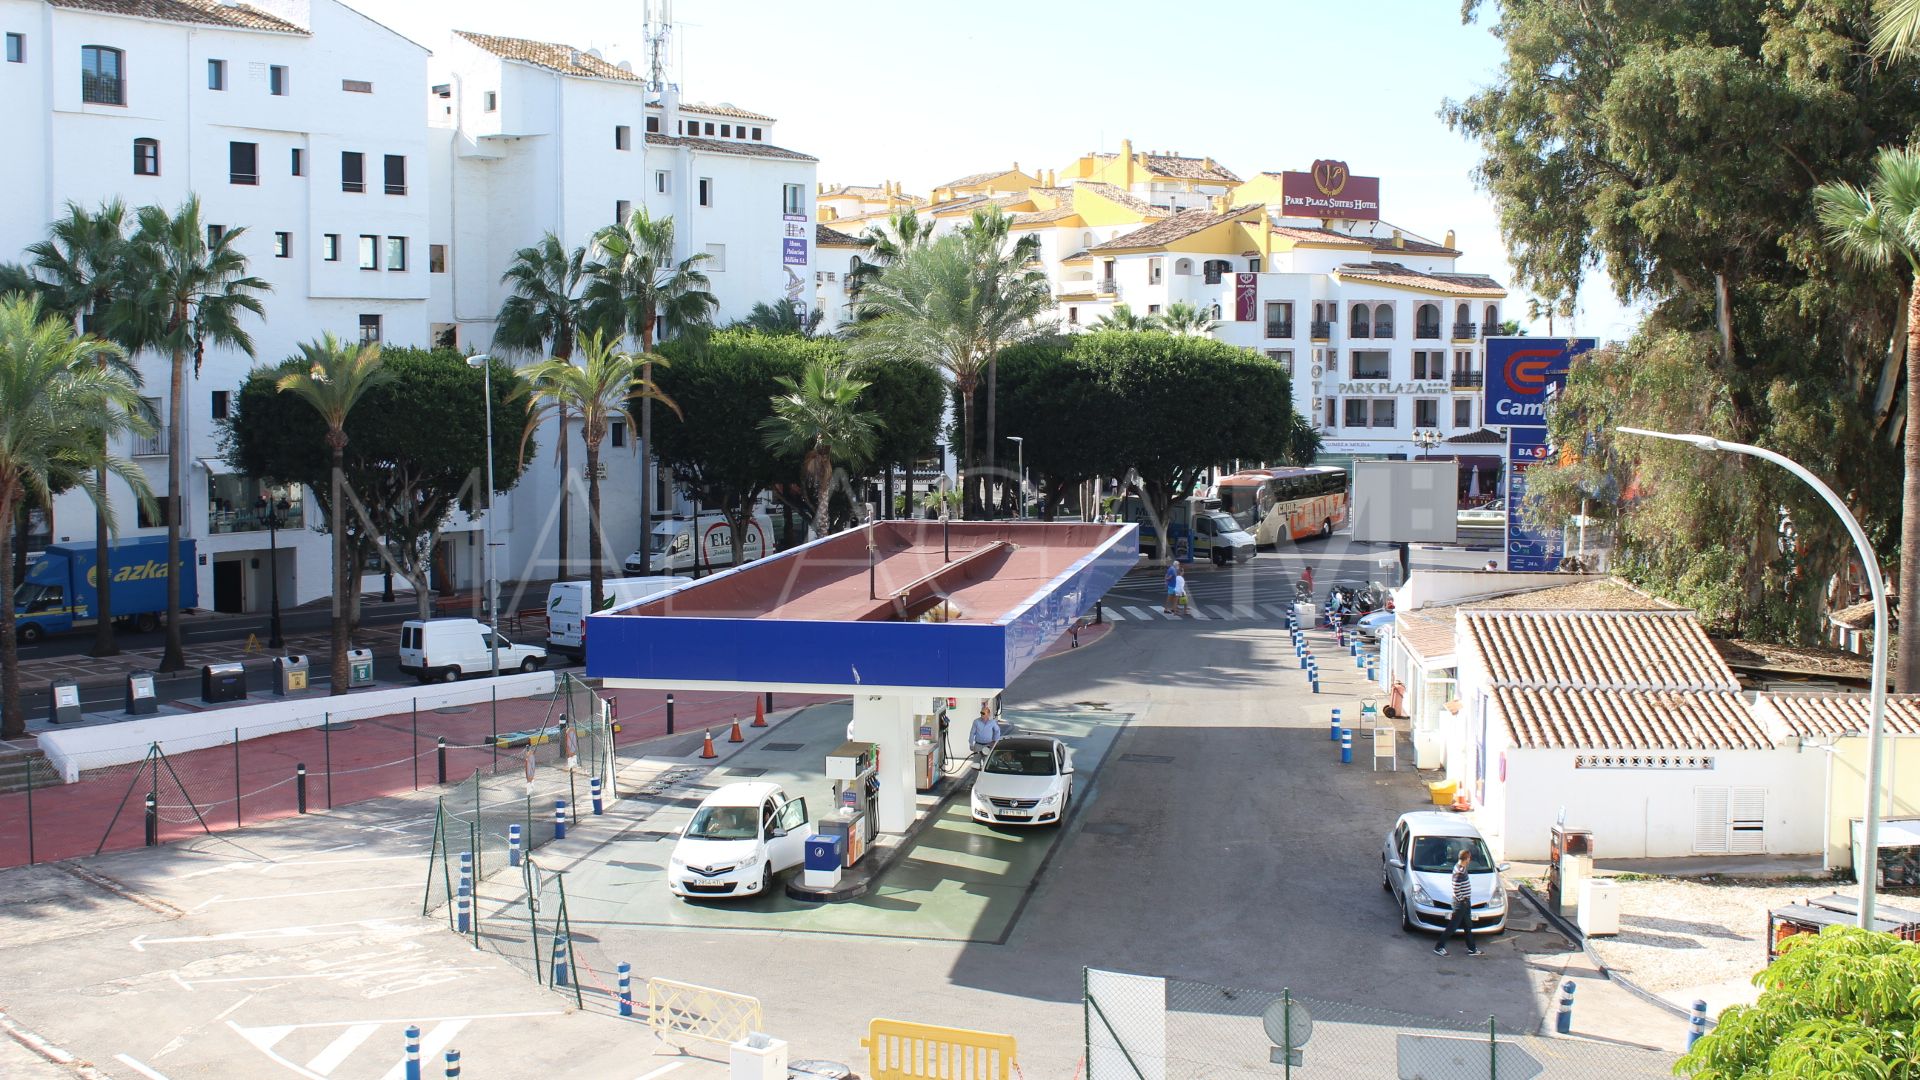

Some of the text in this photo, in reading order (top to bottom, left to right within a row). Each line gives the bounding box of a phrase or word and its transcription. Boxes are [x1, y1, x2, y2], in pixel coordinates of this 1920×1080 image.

[1284, 195, 1378, 210] PARK PLAZA SUITES HOTEL
[1338, 382, 1375, 395] PARK
[1379, 382, 1425, 395] PLAZA
